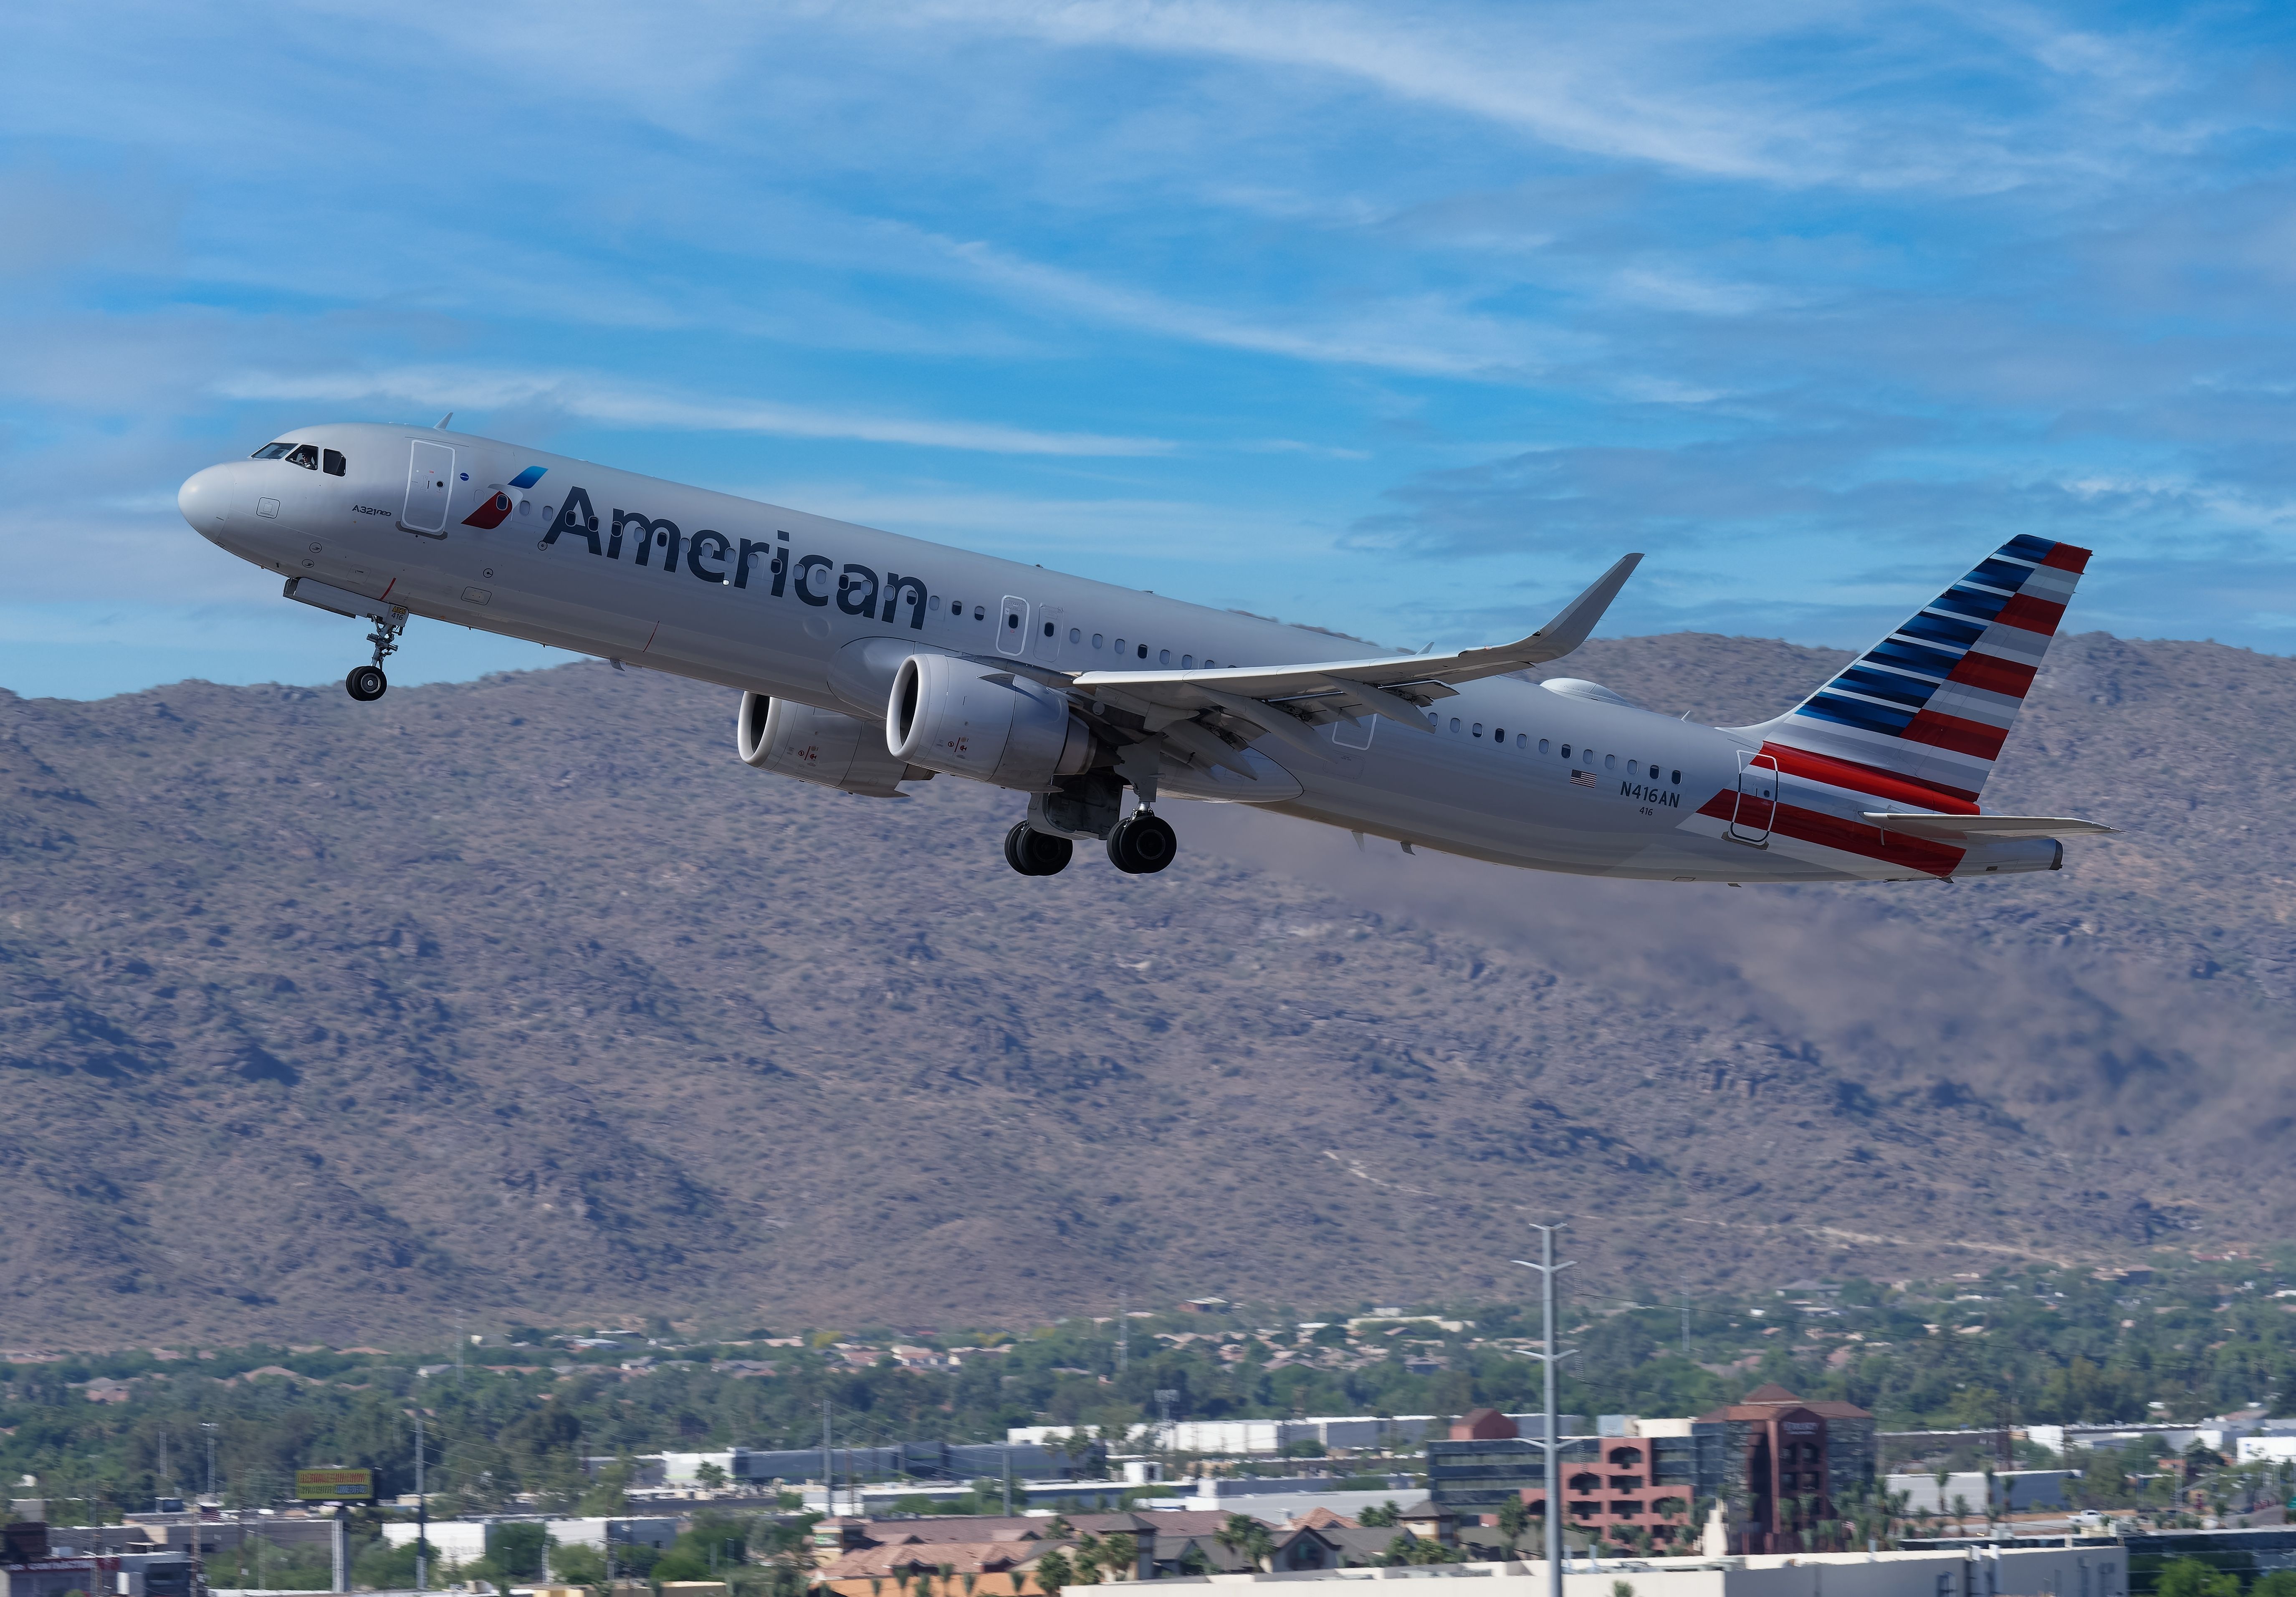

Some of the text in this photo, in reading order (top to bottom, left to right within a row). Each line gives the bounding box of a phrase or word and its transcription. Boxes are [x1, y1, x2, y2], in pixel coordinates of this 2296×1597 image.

[351, 504, 392, 516] A321neo
[543, 486, 928, 630] American
[392, 606, 407, 615] A321
[1620, 781, 1680, 808] N416AN
[1639, 807, 1653, 816] 416
